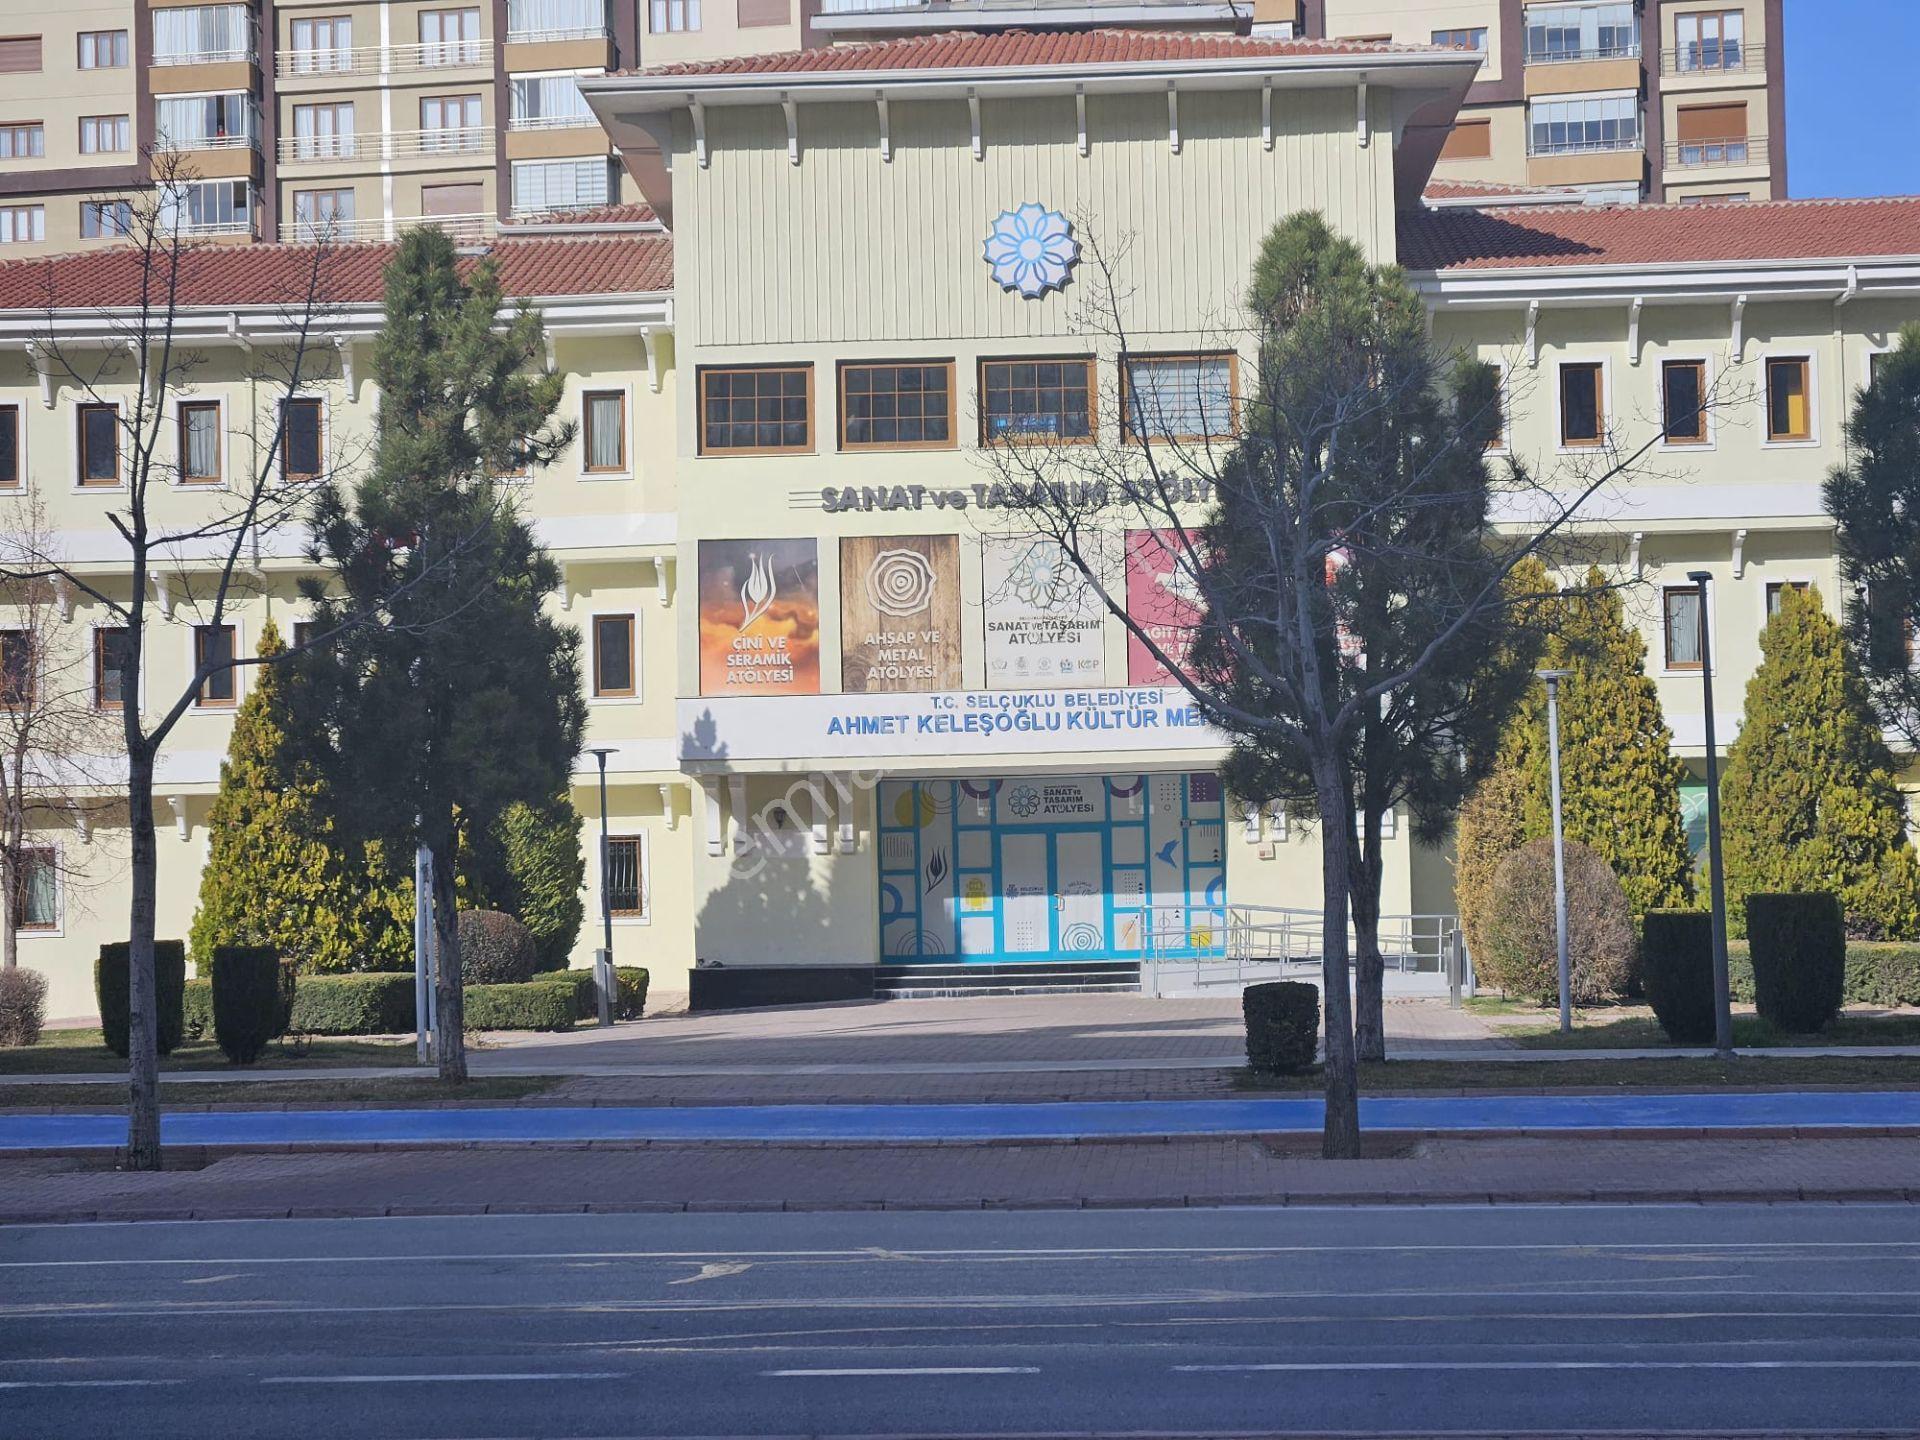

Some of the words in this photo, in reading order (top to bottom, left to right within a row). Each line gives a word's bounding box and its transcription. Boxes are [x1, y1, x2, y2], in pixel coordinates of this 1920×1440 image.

[821, 484, 926, 513] SANAT
[928, 489, 968, 510] ve
[988, 621, 1030, 631] SANAT
[732, 634, 763, 651] ÇİNİ
[767, 636, 787, 650] VE
[864, 631, 916, 647] AHŞAP
[920, 630, 941, 644] VE
[727, 650, 792, 667] SERAMİK
[877, 648, 927, 662] METAL
[726, 666, 794, 684] ATÖLYESİ
[866, 663, 938, 681] ATÖLYESİ
[930, 696, 959, 709] T.C.
[966, 693, 1055, 712] SELÇUKLU
[1064, 689, 1164, 708] BELEDİYESİ
[827, 715, 910, 735] AHMET
[917, 709, 1061, 736] KELEŞOĞLU
[1067, 705, 1160, 729] KÜLTÜR
[1043, 788, 1073, 796] SANAT
